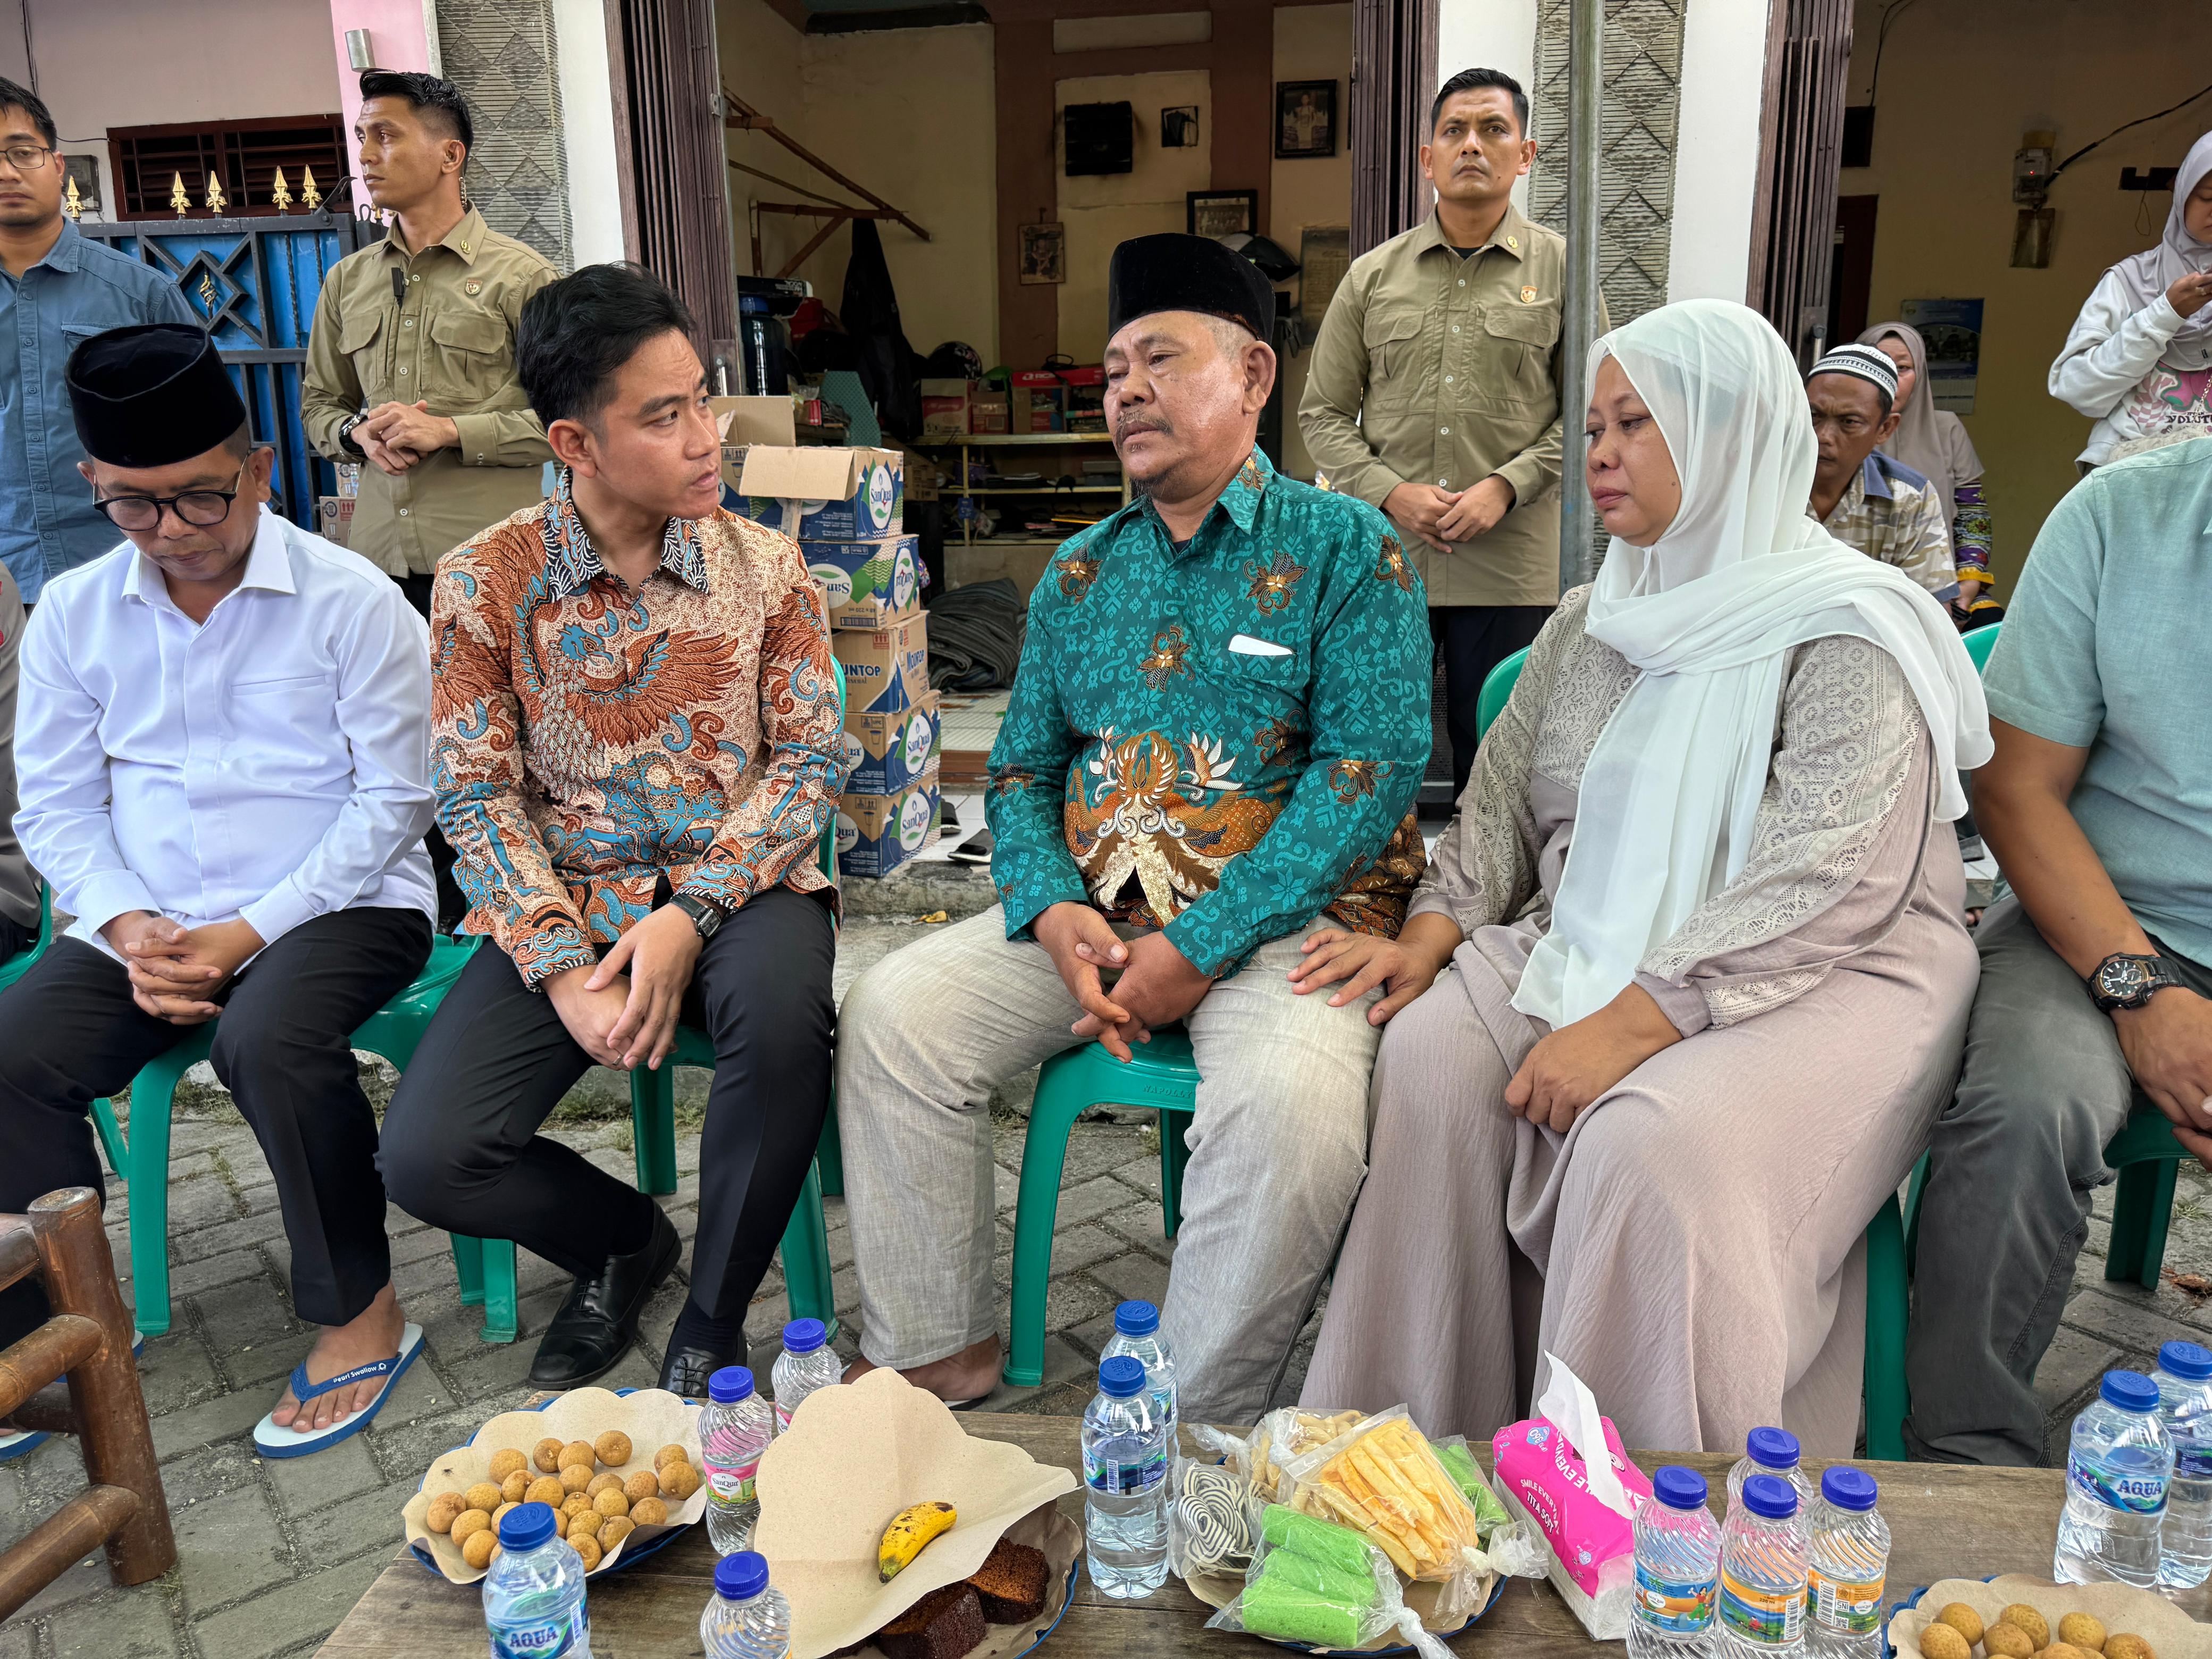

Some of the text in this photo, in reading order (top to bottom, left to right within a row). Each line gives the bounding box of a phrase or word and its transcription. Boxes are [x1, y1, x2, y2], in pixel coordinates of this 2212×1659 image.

[870, 488, 892, 507] SanQua
[826, 583, 850, 594] San
[842, 664, 881, 677] UNTOP
[908, 732, 931, 756] SanQua
[902, 809, 929, 833] SanQua
[1143, 1084, 1193, 1099] NAPOLLY
[333, 1365, 377, 1384] Pearl Swallow
[1529, 1429, 1544, 1444] 360
[1520, 1479, 1538, 1491] SMILE
[2117, 1480, 2162, 1498] AQUA
[1527, 1490, 1555, 1534] TITA SOFT
[1837, 1602, 1849, 1611] SNI
[509, 1626, 558, 1648] AQUA
